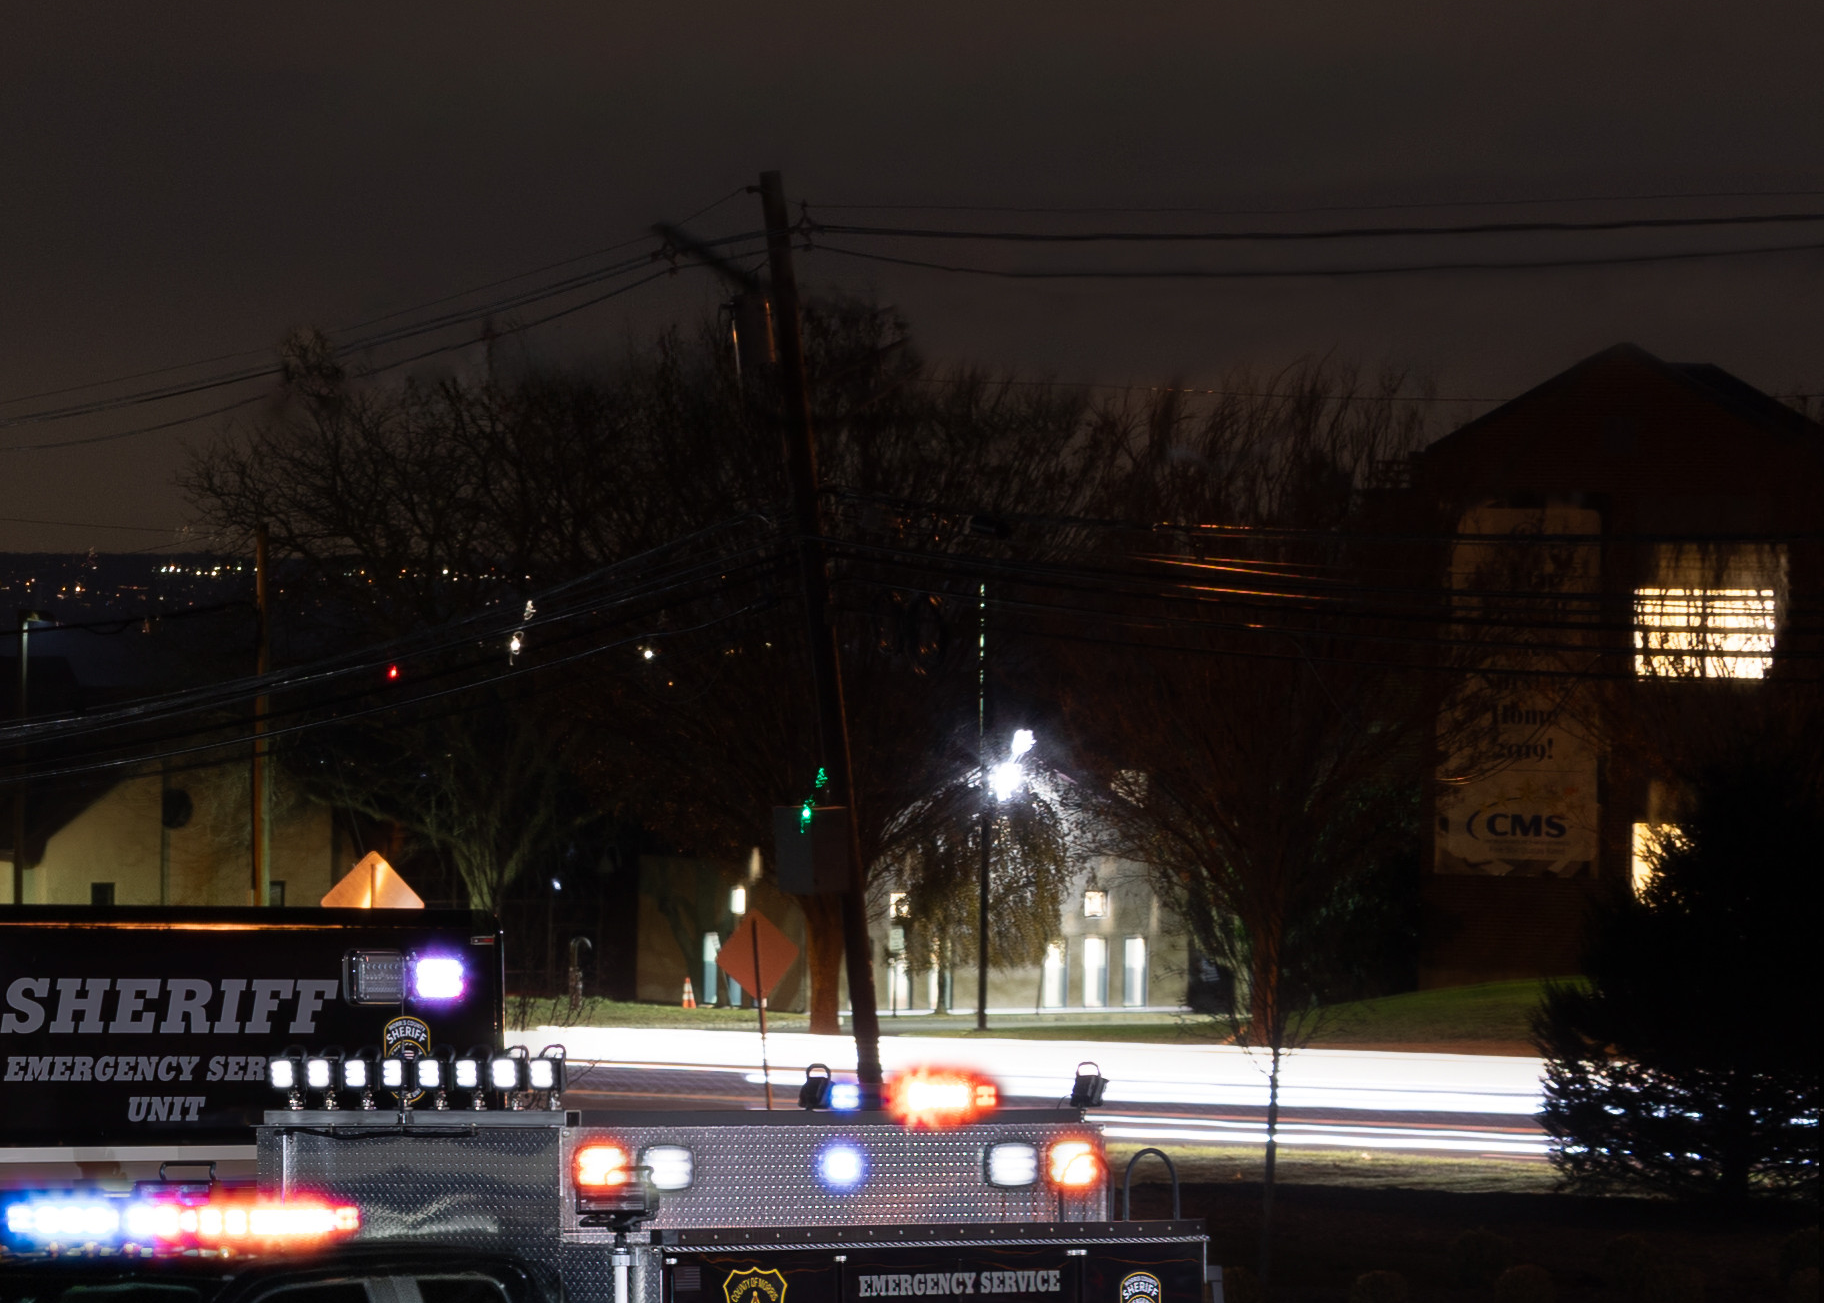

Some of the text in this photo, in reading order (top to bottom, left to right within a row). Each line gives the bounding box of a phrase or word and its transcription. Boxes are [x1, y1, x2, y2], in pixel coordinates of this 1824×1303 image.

[1486, 812, 1569, 839] CMS
[1, 977, 340, 1035] SHERIFF
[386, 1026, 428, 1045] SHERIFF
[3, 1055, 201, 1083] EMERGENCY
[126, 1096, 207, 1122] UNIT
[858, 1270, 1061, 1298] EMERGENCY SERVICE
[1122, 1281, 1159, 1300] SHERIFF
